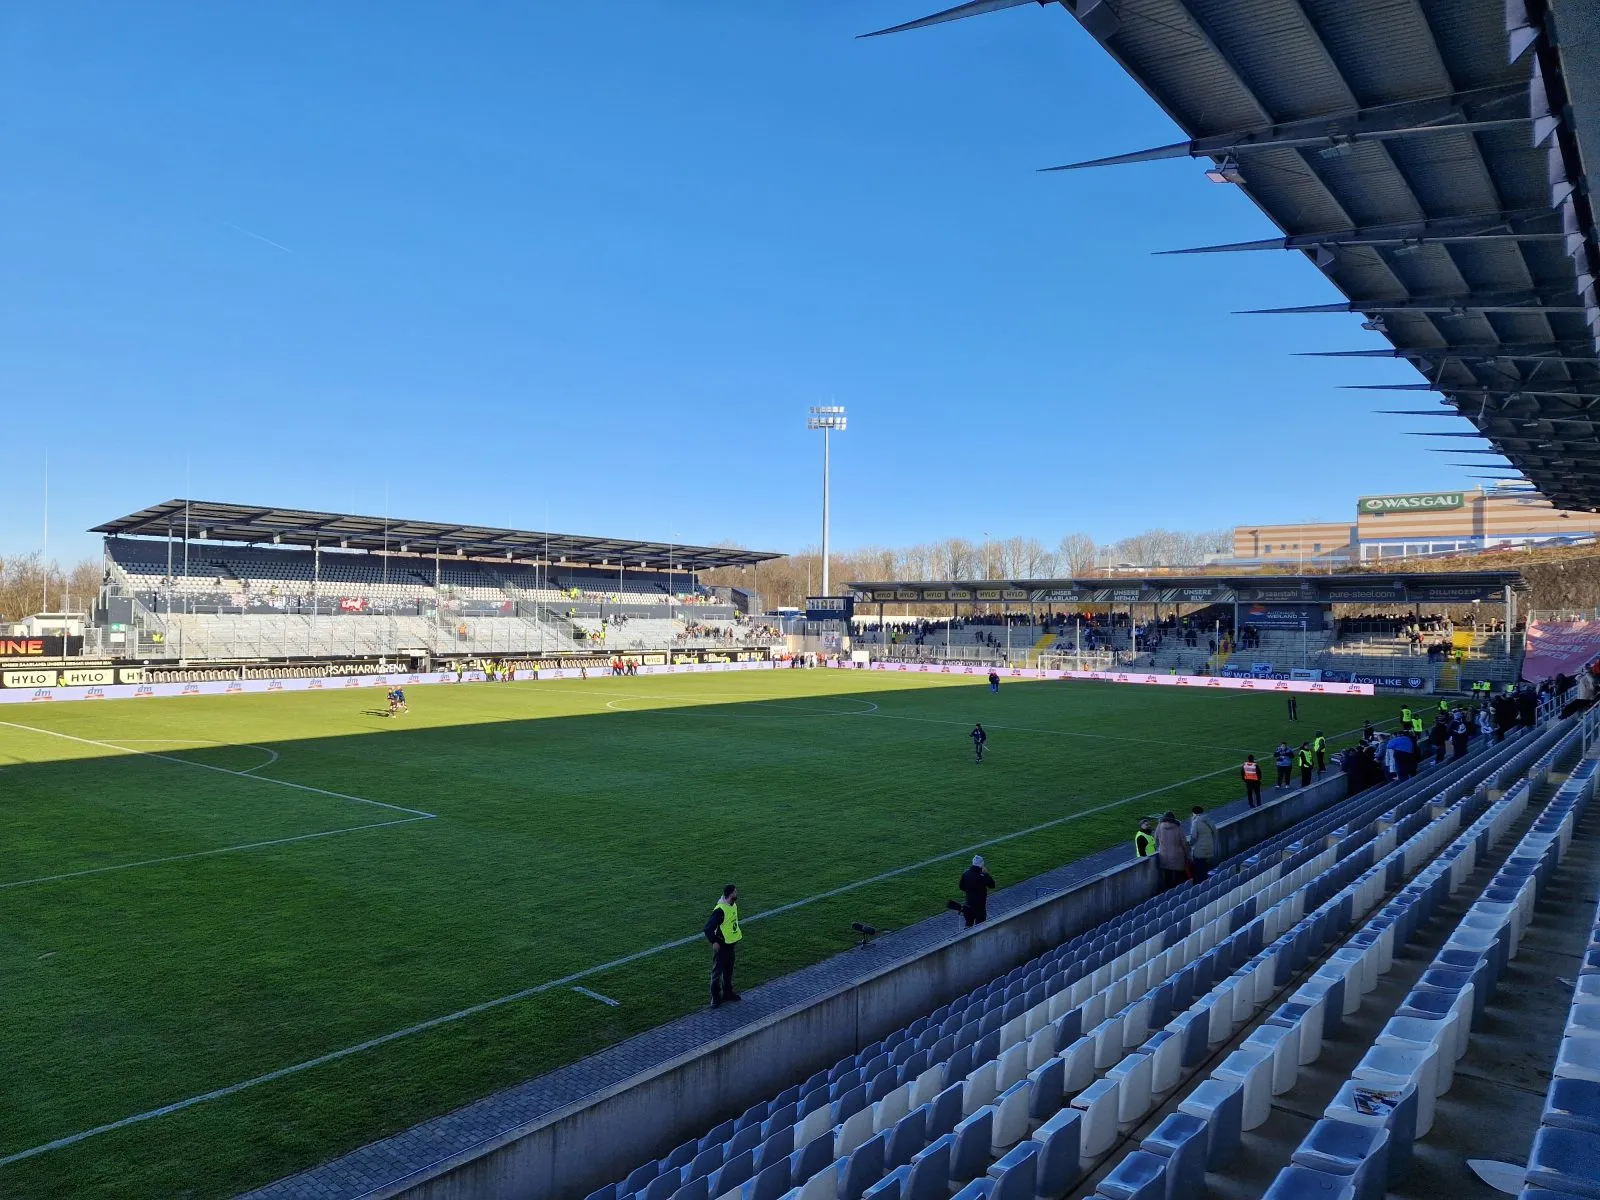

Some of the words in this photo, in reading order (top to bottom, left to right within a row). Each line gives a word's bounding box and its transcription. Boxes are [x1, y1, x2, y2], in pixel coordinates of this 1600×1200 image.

[1382, 495, 1459, 508] WASGAU
[1328, 590, 1396, 599] pure-steel.com
[0, 640, 42, 654] INE
[12, 675, 46, 684] HYLO
[71, 673, 104, 682] HYLO
[34, 689, 51, 697] dm
[88, 687, 102, 695] dm
[137, 685, 152, 693] dm
